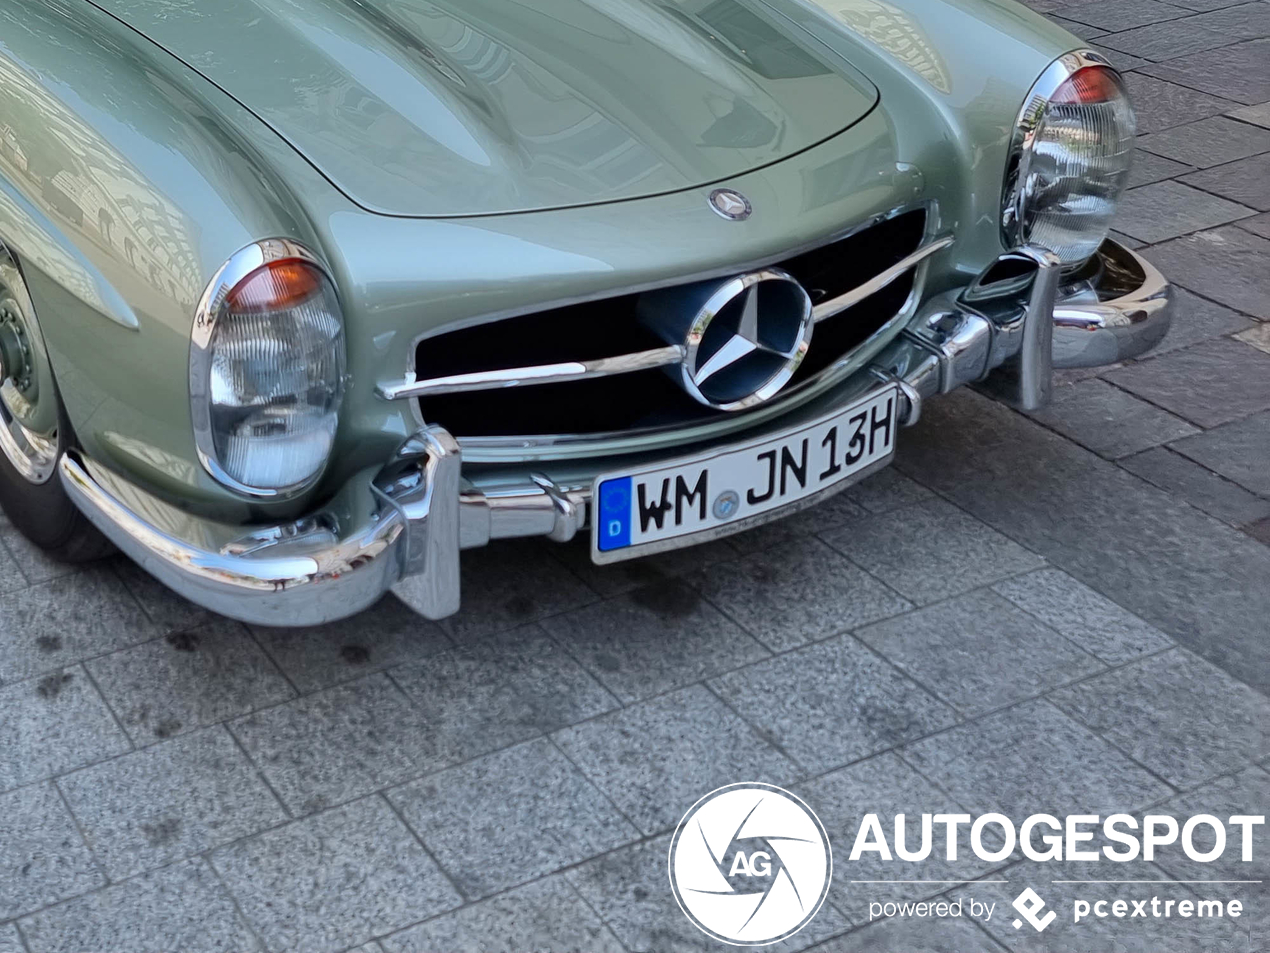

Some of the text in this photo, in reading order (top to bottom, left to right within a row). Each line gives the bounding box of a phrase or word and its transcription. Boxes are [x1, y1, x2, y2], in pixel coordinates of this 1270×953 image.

[637, 469, 708, 533] WM
[746, 438, 809, 505] JN
[819, 398, 894, 482] 13H
[608, 520, 622, 537] D
